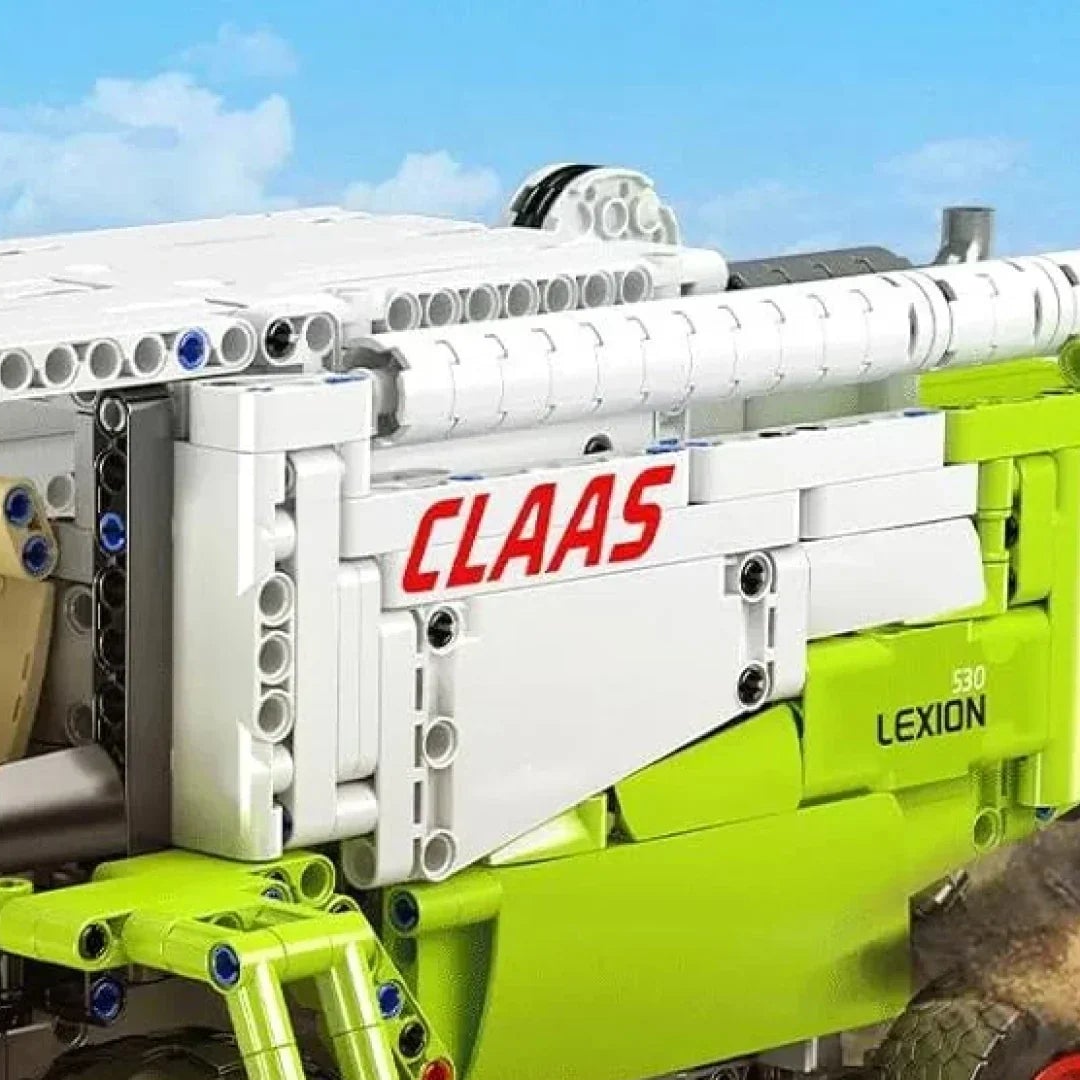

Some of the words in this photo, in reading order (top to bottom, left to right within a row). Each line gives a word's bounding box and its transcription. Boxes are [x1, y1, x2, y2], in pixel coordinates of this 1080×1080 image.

[403, 465, 676, 593] CLAAS
[952, 665, 984, 693] 530
[878, 695, 985, 746] LEXION
